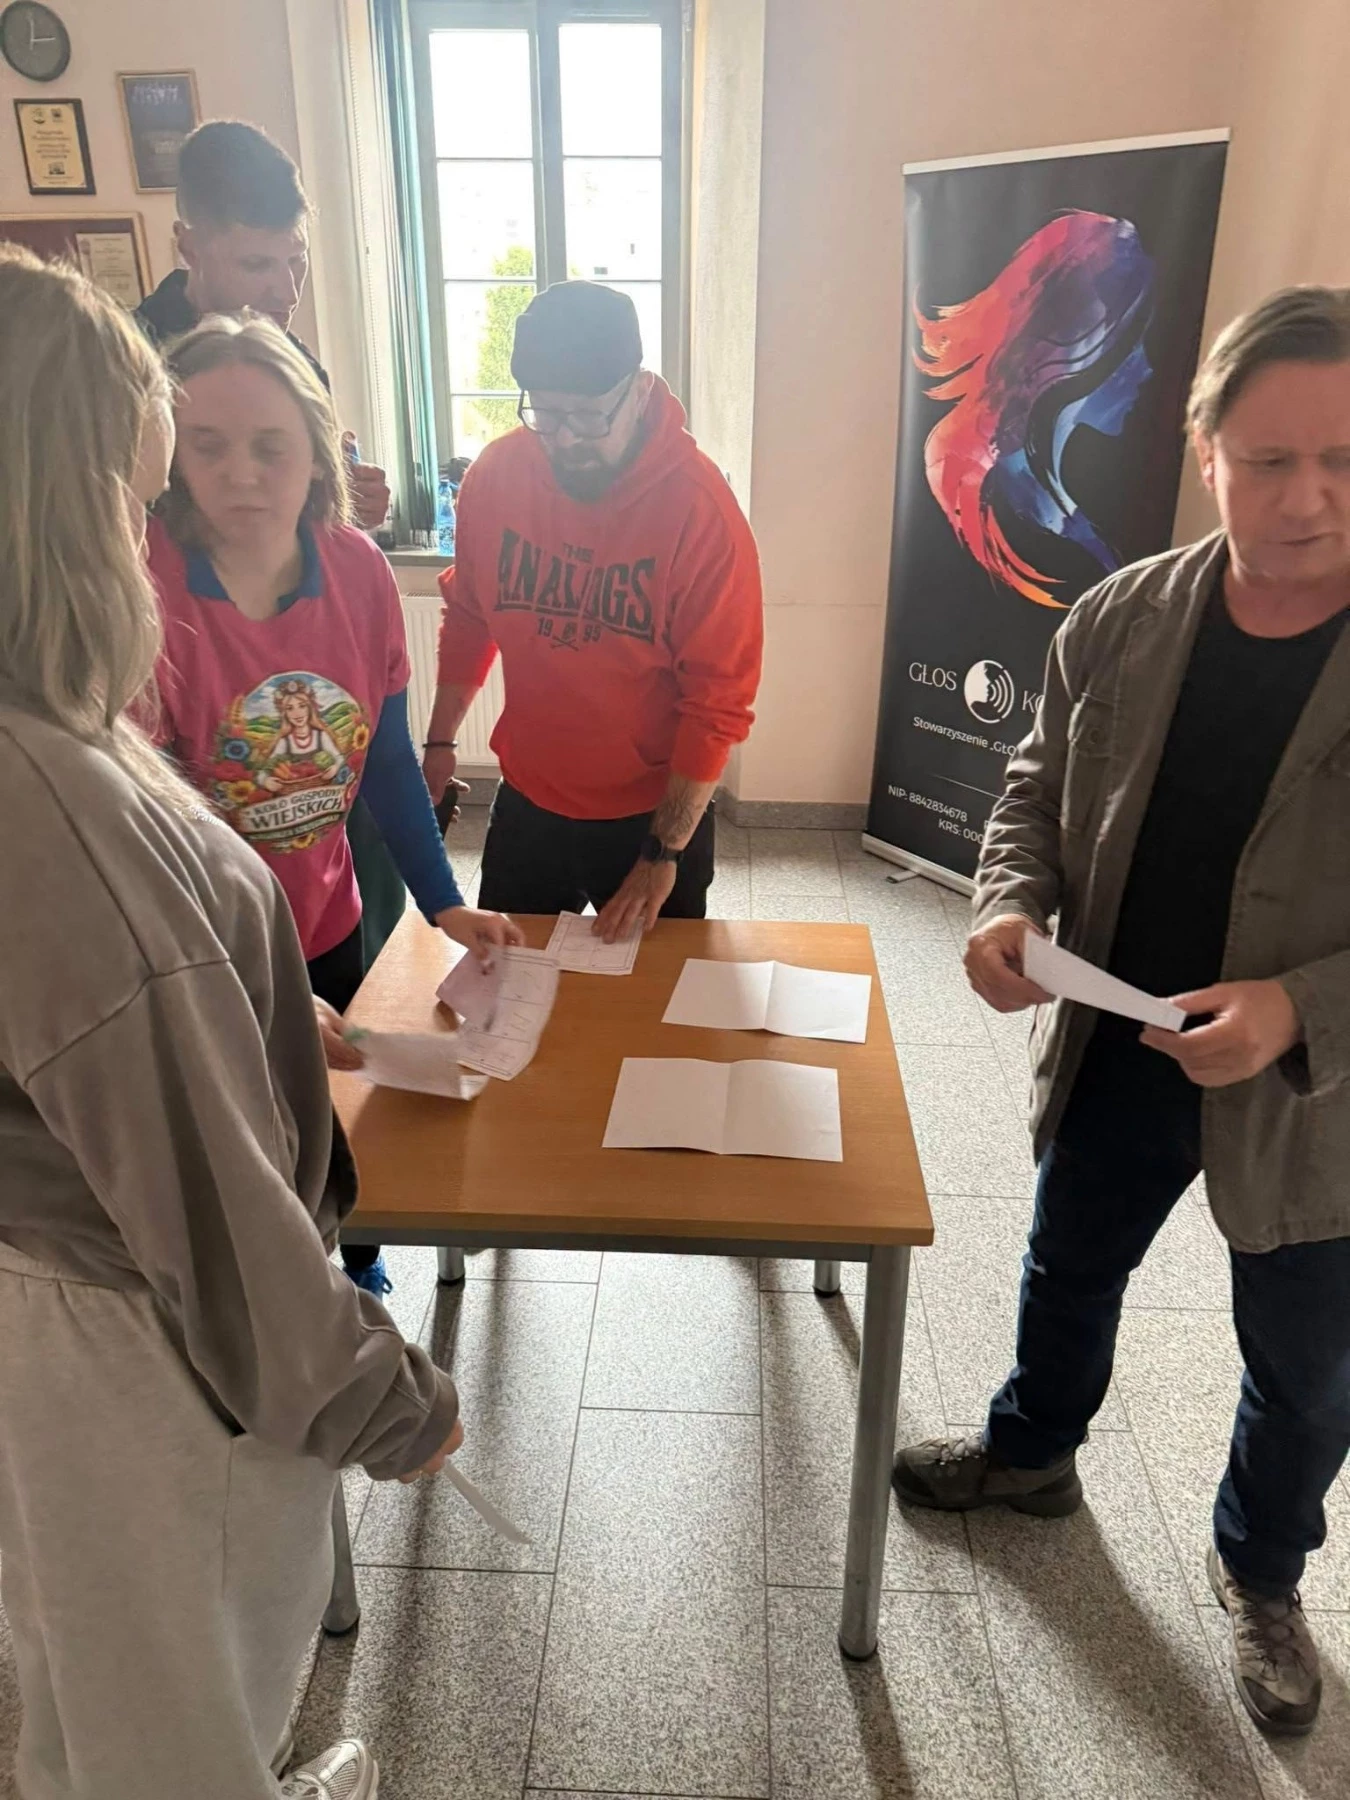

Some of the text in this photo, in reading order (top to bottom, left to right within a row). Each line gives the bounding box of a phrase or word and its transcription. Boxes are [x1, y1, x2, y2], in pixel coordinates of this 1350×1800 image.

[913, 716, 988, 748] Stowarzyszenie
[251, 797, 342, 829] WIEJSKICH
[888, 785, 968, 822] NIP: 8842834678
[938, 818, 961, 836] KRS:
